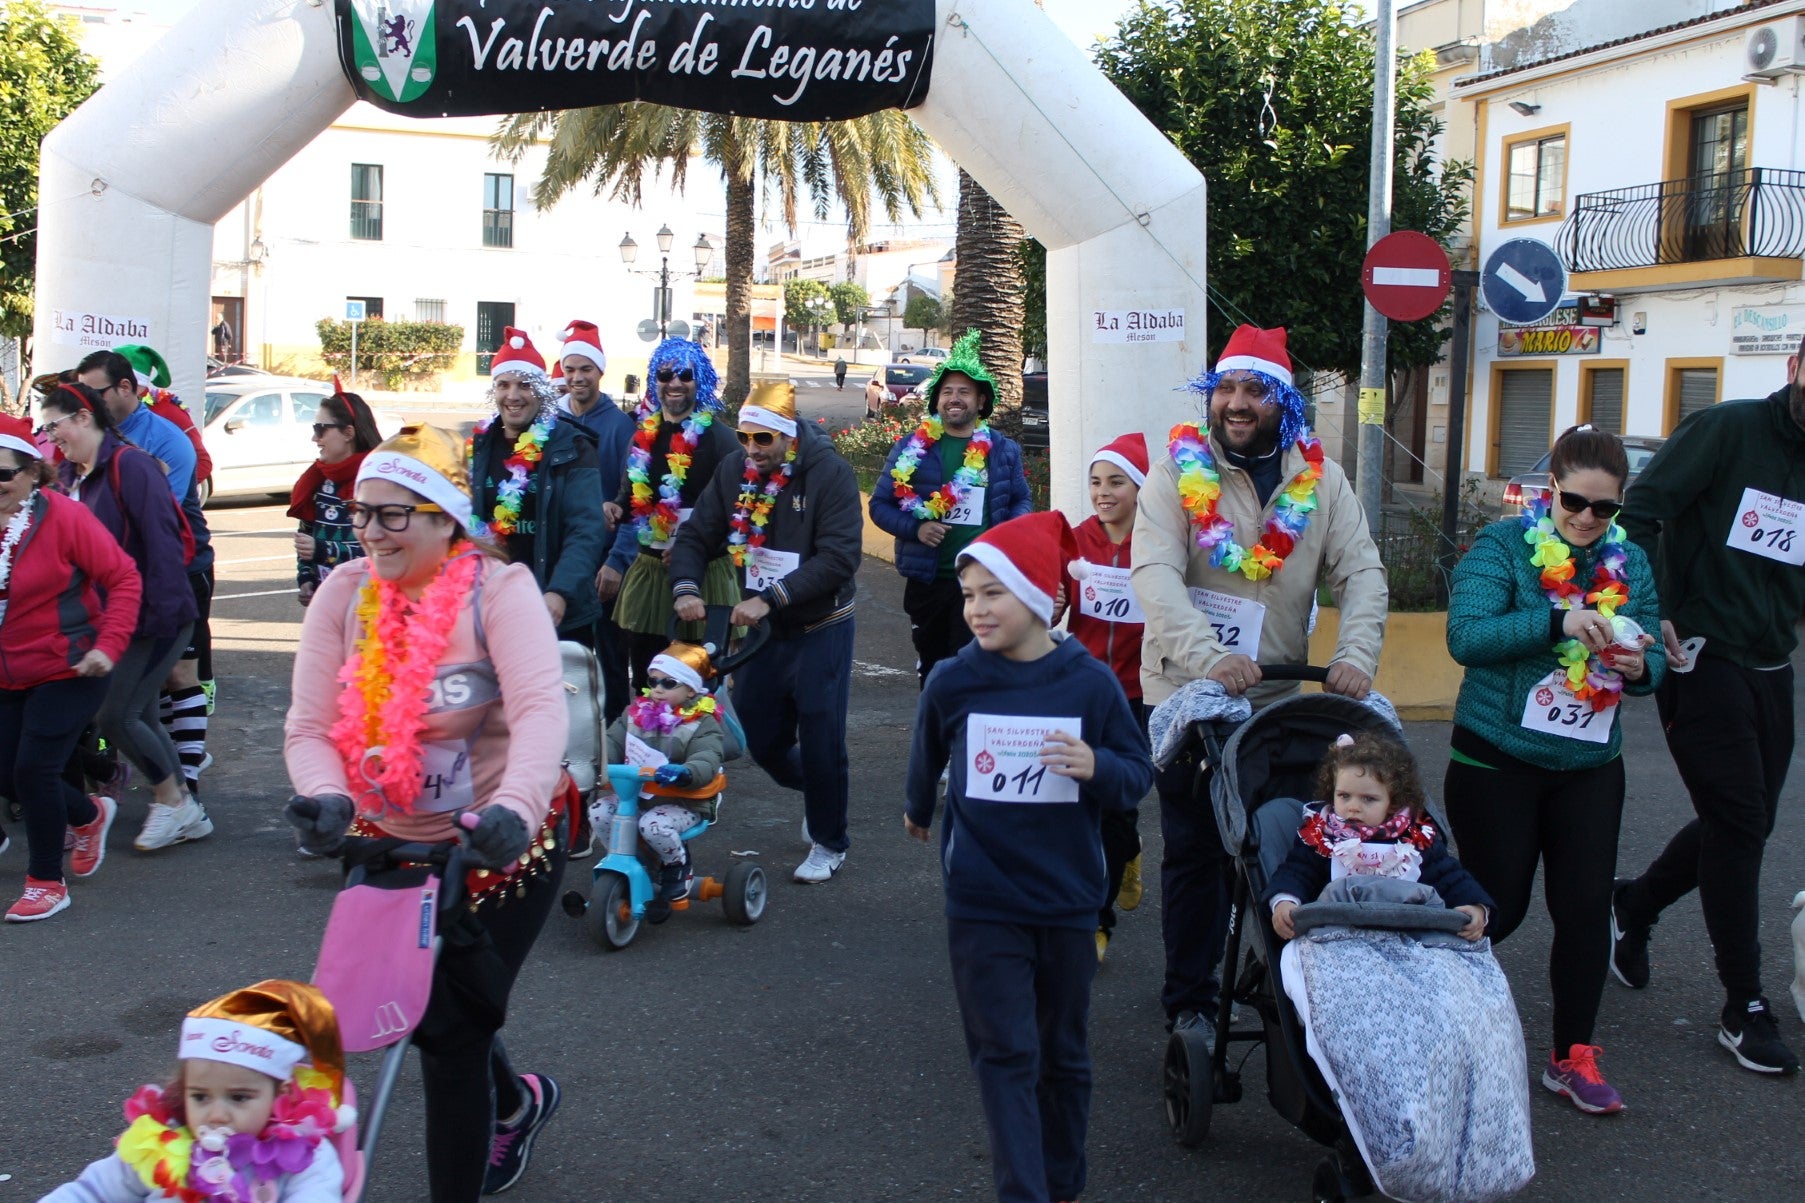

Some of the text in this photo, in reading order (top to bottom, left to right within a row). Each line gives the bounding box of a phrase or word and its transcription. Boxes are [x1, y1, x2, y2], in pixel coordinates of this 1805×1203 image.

[456, 7, 912, 105] Valverde de Leganés
[54, 310, 148, 338] La Aldaba
[1094, 311, 1184, 331] La Aldaba
[80, 336, 111, 347] Mesón
[1126, 332, 1156, 342] Mesón
[1520, 329, 1573, 354] MARIO
[944, 507, 972, 522] 029
[1750, 528, 1798, 553] 018
[1094, 597, 1130, 618] 010
[1547, 704, 1596, 728] 031
[992, 764, 1047, 796] 011
